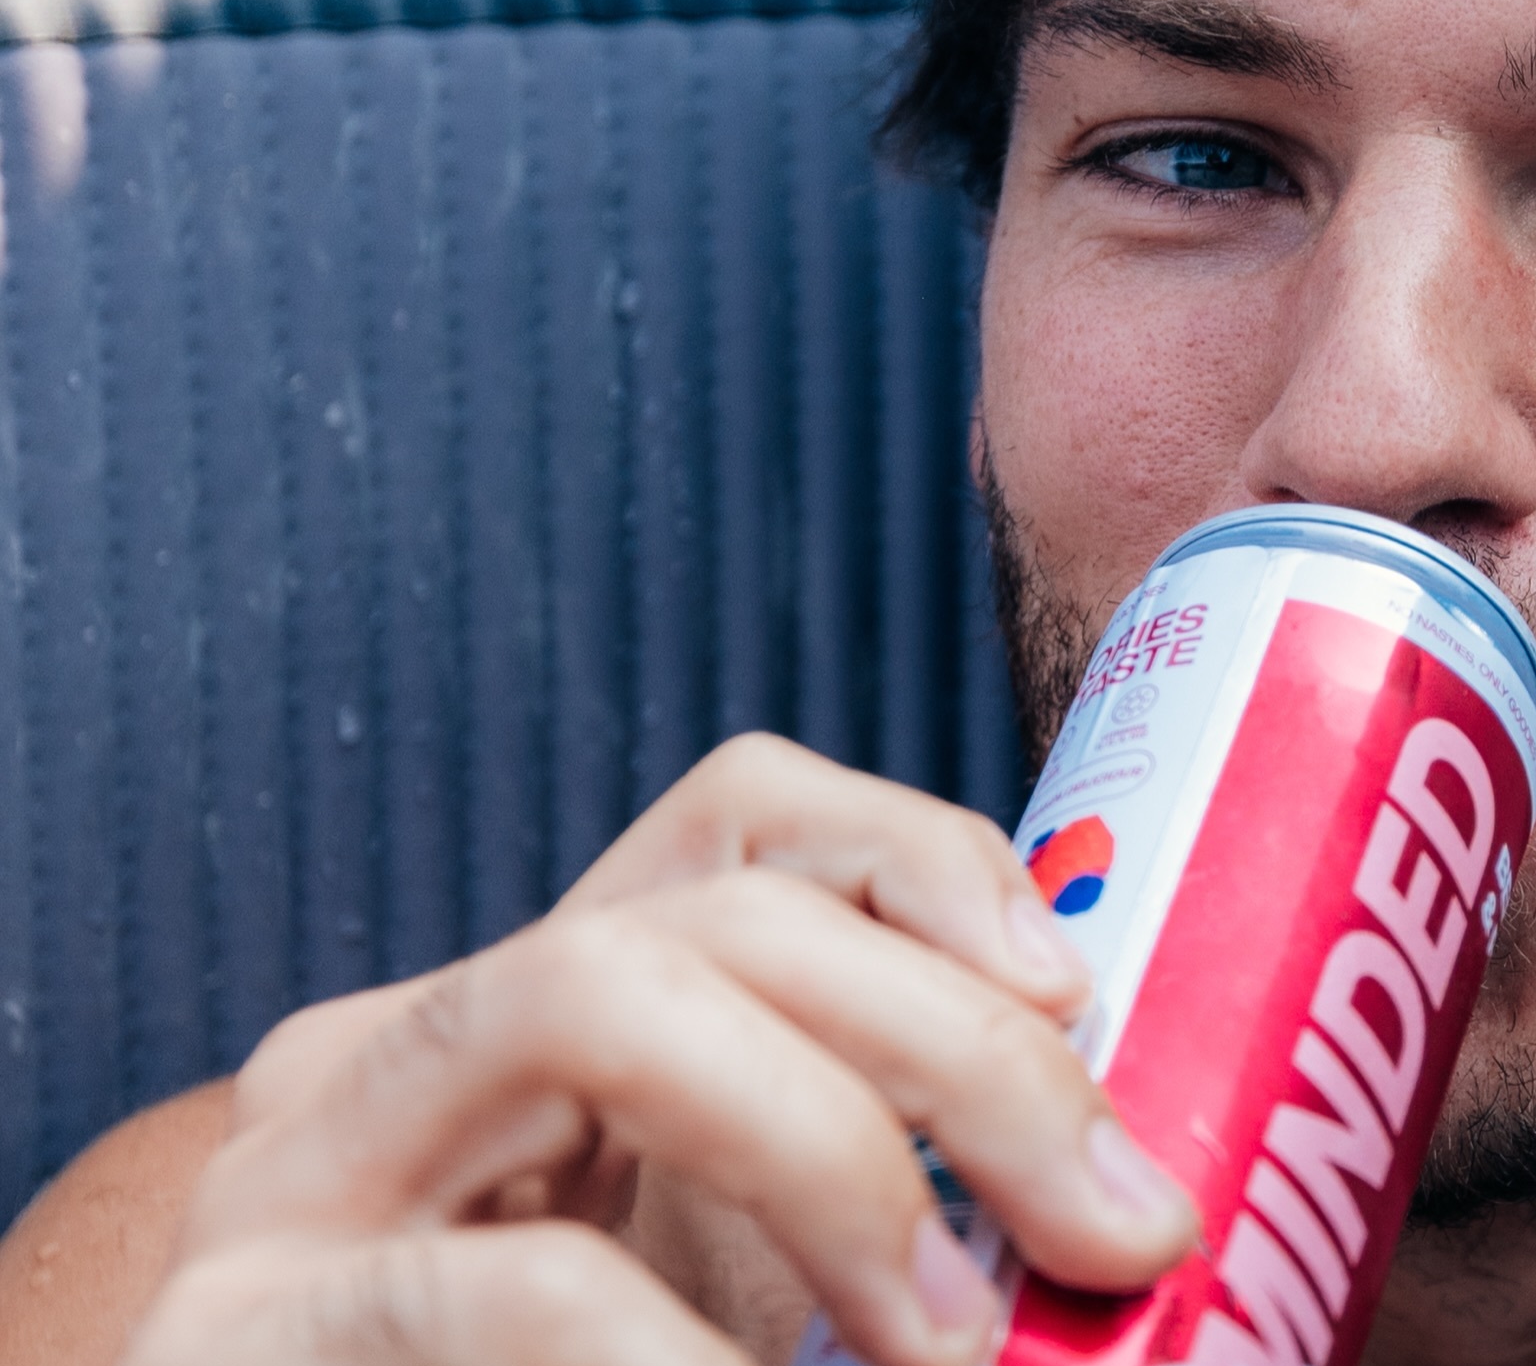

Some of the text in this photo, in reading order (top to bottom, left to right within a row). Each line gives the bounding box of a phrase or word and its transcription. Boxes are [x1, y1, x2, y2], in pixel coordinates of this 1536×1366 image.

[1087, 603, 1208, 681] ORIES
[1415, 613, 1476, 669] NASTIES,
[1479, 662, 1508, 697] ONLY
